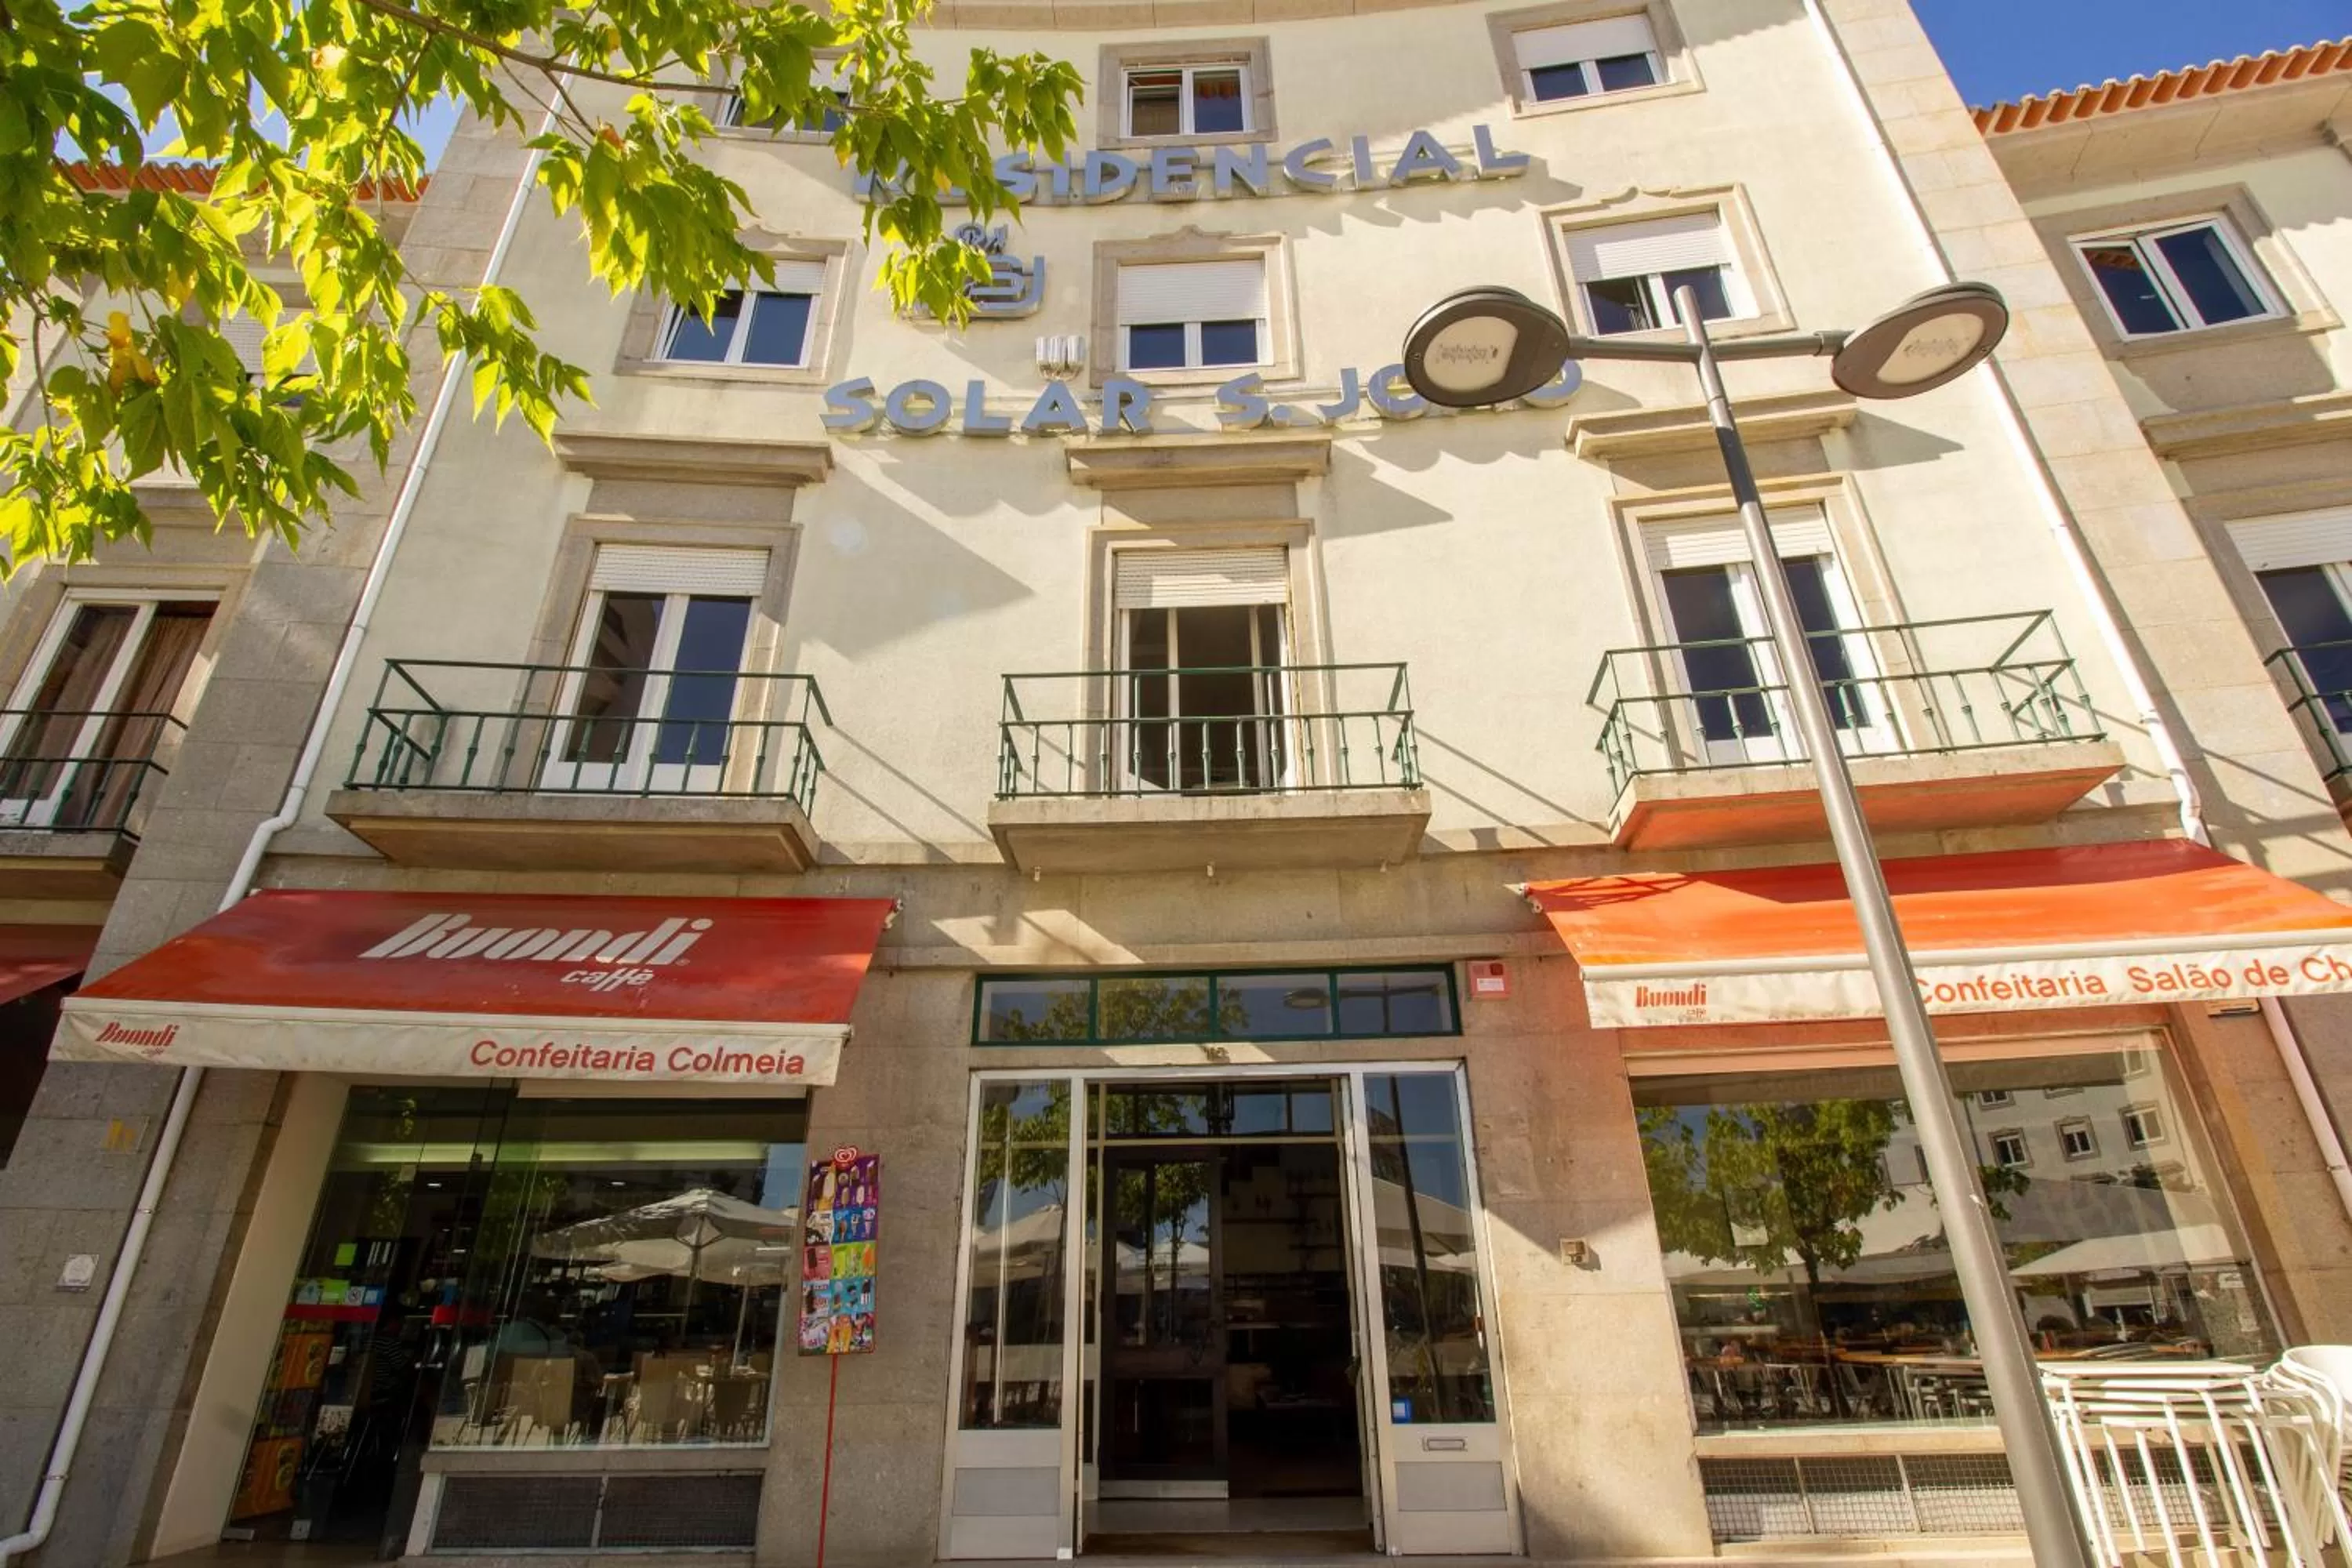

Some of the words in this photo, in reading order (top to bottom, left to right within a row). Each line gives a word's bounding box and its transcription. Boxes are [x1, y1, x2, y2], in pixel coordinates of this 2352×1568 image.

[852, 124, 1530, 205] SIDENCIAL
[819, 376, 1156, 437] SOLAR
[1214, 372, 1294, 431] S.
[1317, 359, 1583, 426] JOO
[356, 913, 714, 966] Buondi
[559, 967, 657, 993] caffè
[2127, 963, 2232, 993] Salão
[2242, 958, 2290, 987] de
[1635, 982, 1707, 1007] Buondi
[94, 1022, 181, 1047] Buondi
[470, 1040, 656, 1073] Confeitaria
[666, 1046, 805, 1075] Colmeia
